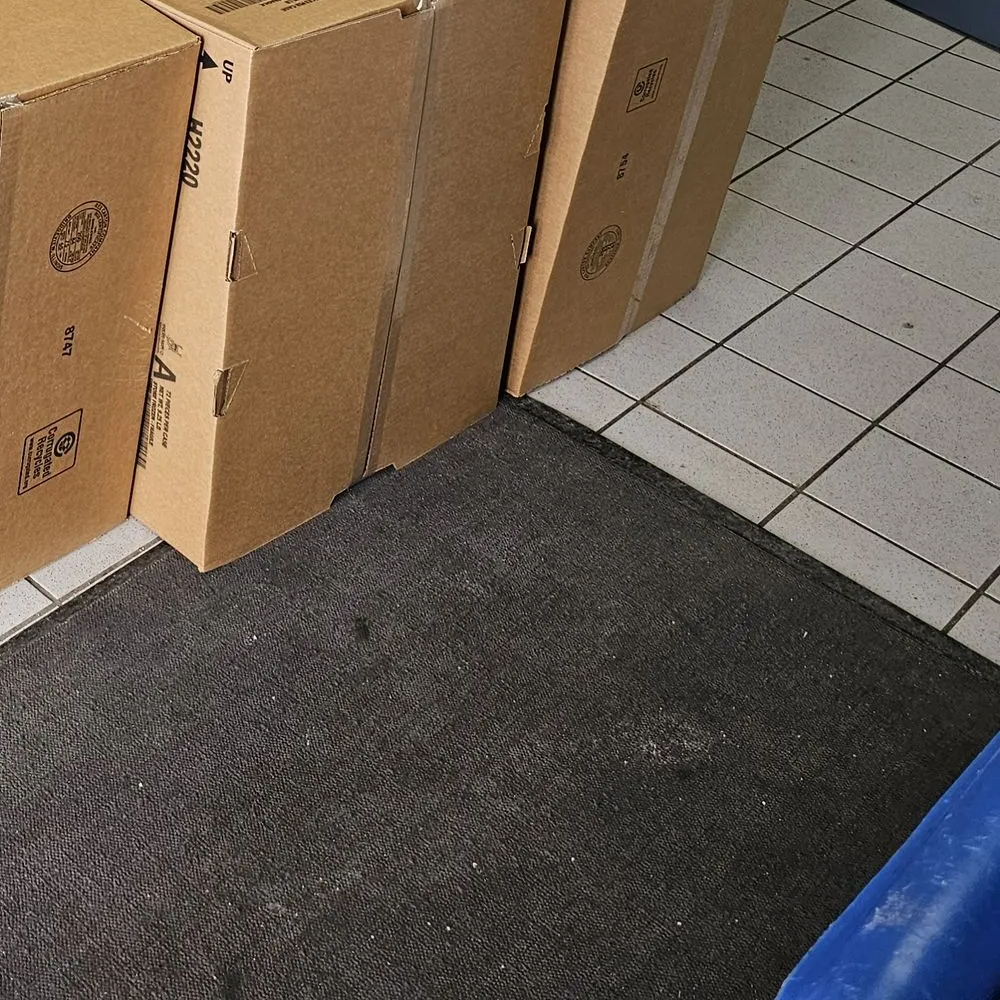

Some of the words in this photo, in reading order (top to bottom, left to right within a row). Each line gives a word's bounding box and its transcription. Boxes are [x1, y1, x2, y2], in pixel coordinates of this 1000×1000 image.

[222, 59, 234, 84] UP
[182, 117, 204, 189] H2220
[62, 324, 75, 357] 8747
[32, 435, 47, 479] Recycles
[42, 426, 58, 479] Corrugated
